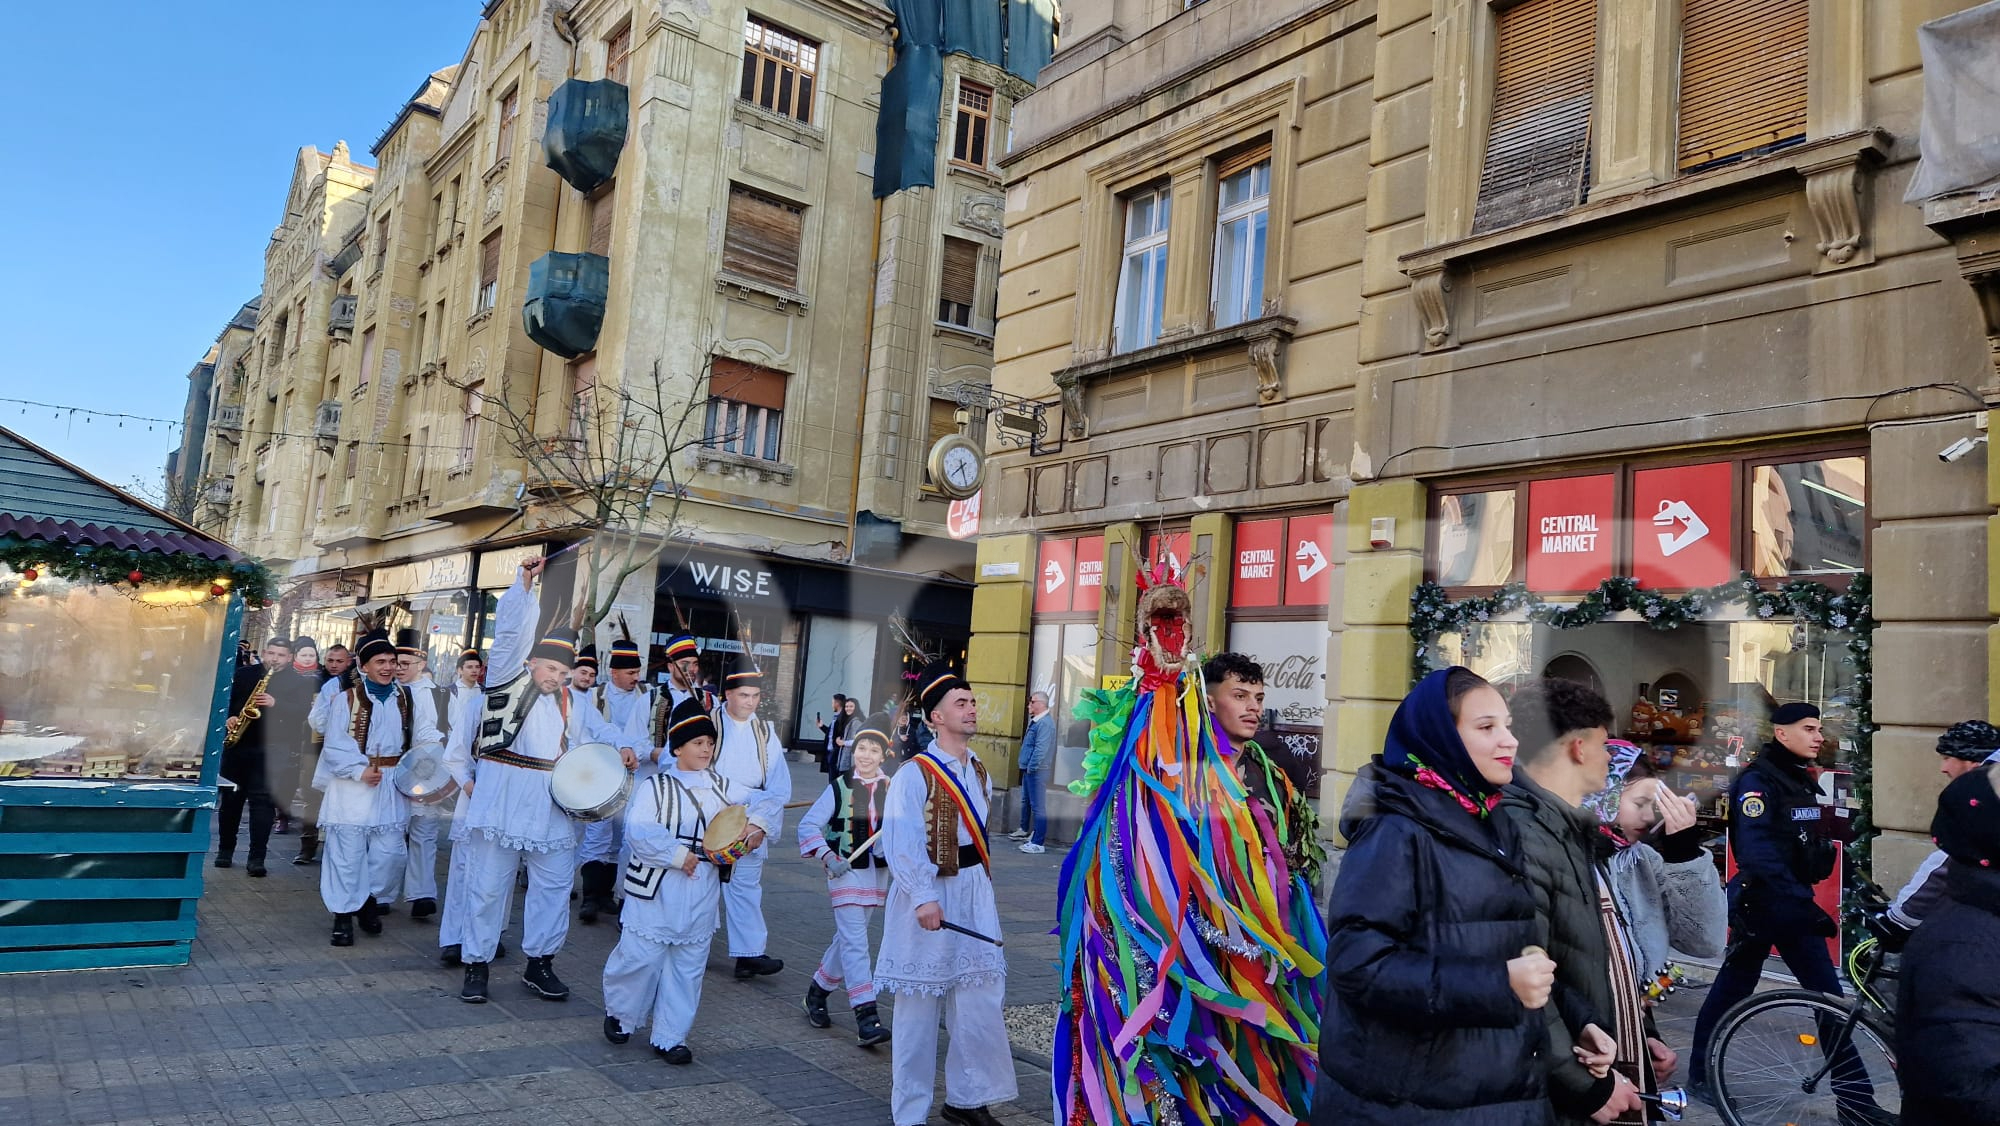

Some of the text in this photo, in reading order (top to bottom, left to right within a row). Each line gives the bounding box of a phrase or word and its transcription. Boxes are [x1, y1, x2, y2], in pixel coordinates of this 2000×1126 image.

[1541, 514, 1599, 534] CENTRAL
[1541, 534, 1597, 553] MARKET
[1240, 549, 1275, 564] CENTRAL
[689, 561, 772, 596] WISE
[1240, 564, 1274, 579] MARKET
